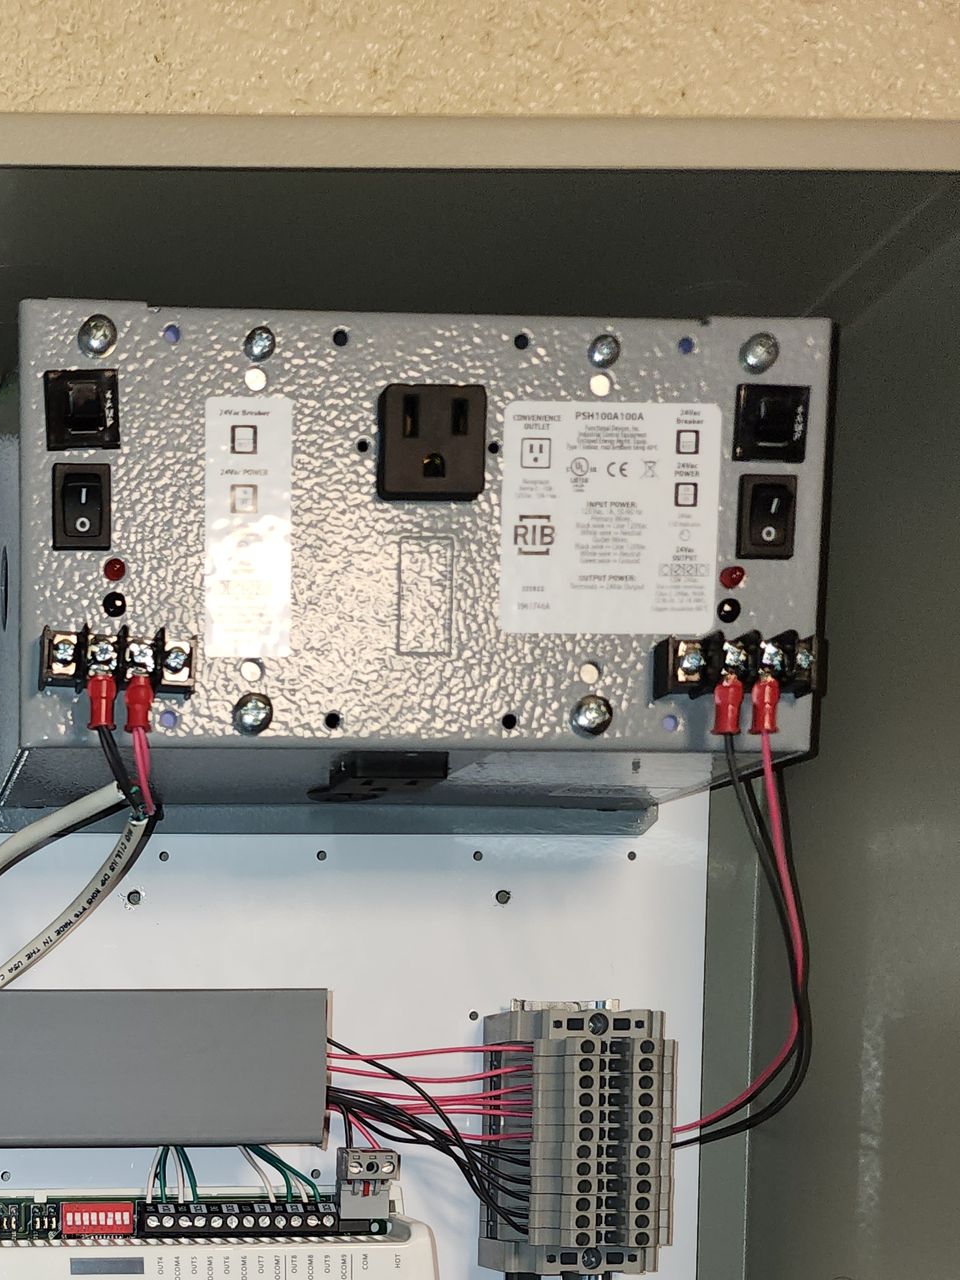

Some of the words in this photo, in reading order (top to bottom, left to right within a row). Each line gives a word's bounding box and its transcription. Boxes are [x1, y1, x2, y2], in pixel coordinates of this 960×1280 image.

[514, 525, 555, 545] RIB
[55, 920, 73, 936] MADE
[43, 936, 52, 946] IN
[25, 948, 40, 960] THE
[8, 961, 23, 973] USA
